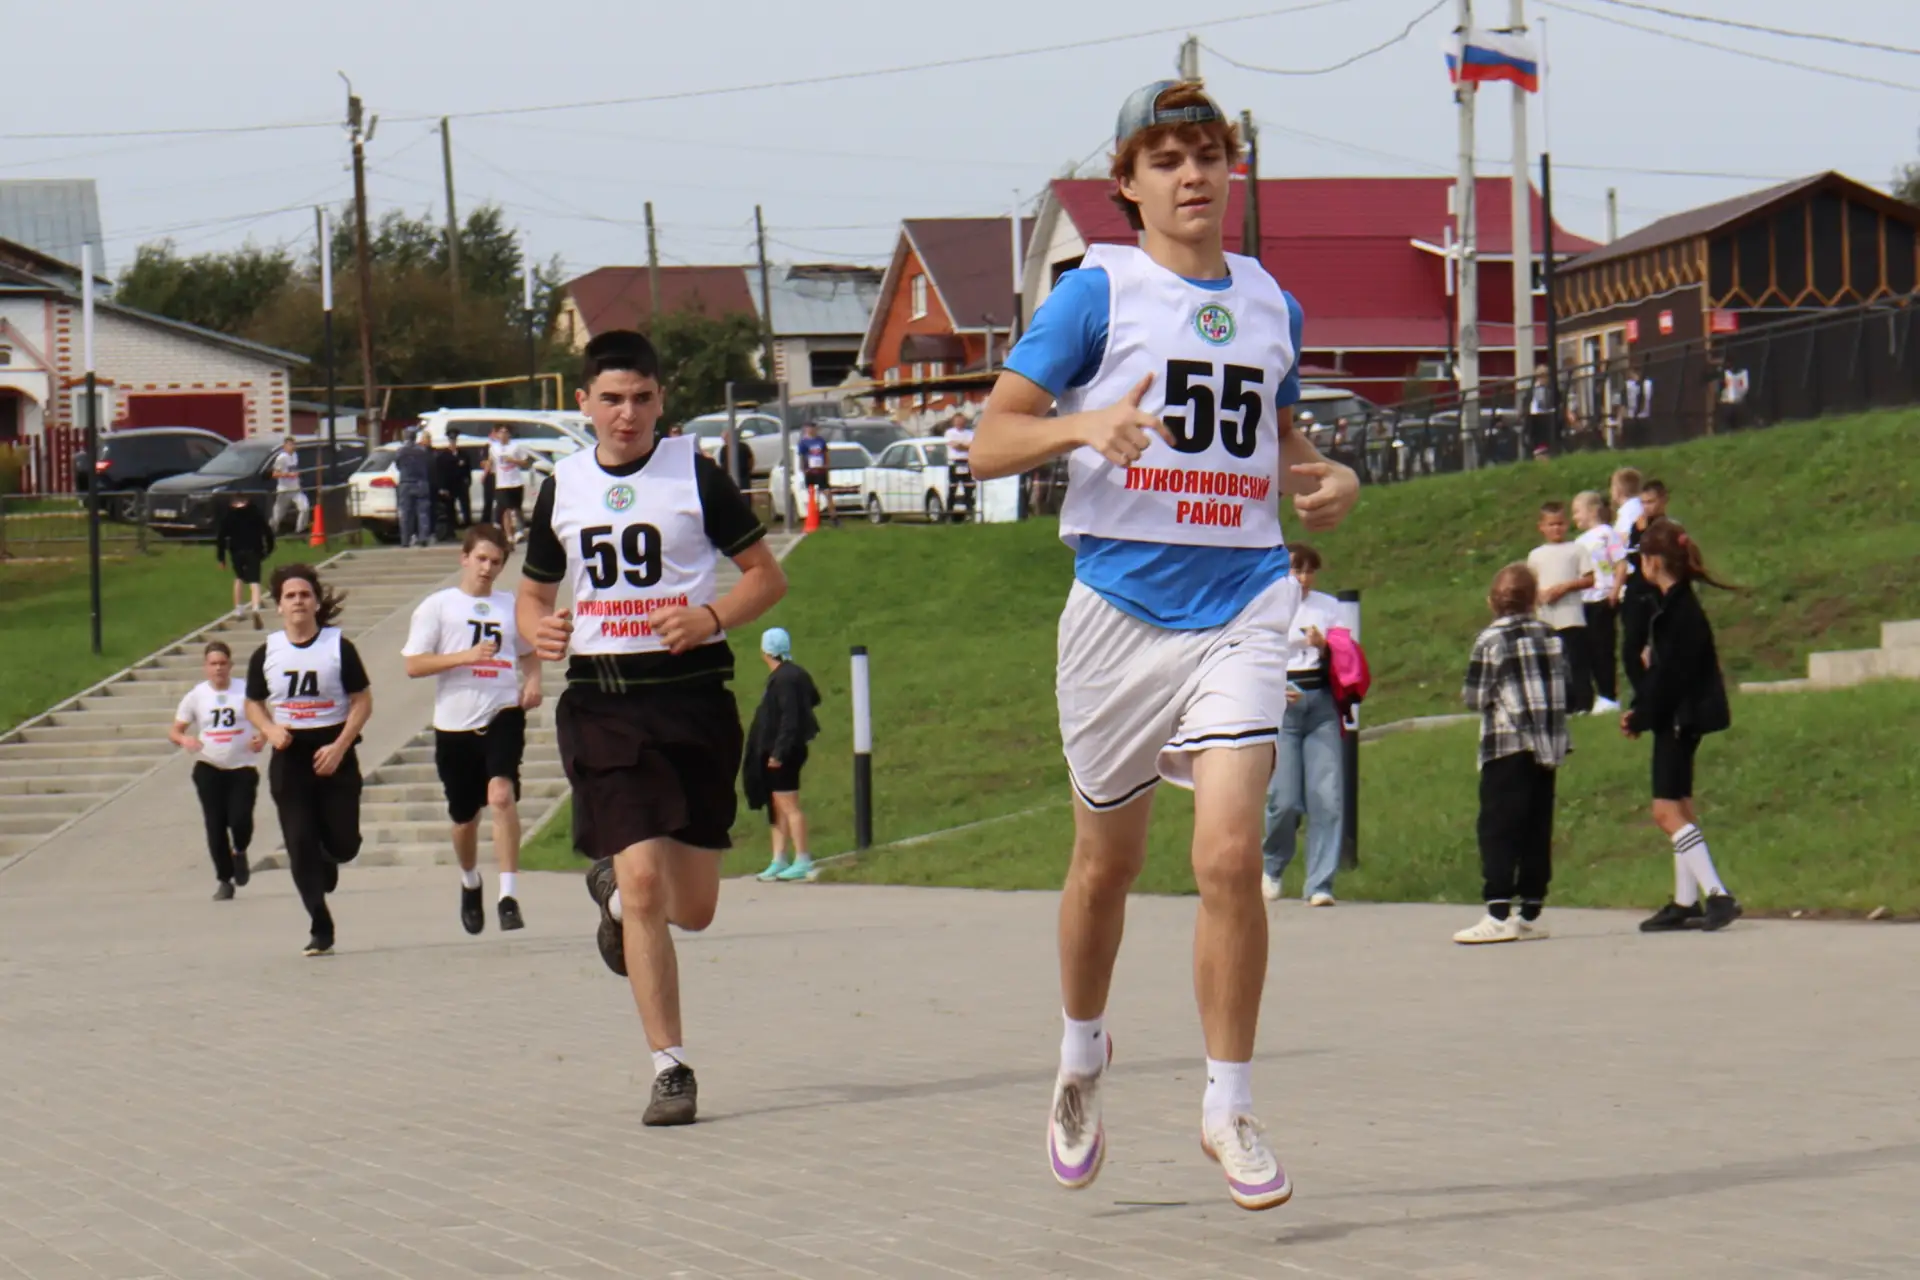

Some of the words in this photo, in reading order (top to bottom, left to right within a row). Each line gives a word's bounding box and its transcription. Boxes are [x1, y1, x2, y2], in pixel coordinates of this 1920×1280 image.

[1163, 359, 1264, 458] 55
[1125, 467, 1271, 501] ЛУКОЯНОВСКИЙ
[1176, 498, 1243, 528] РАЙОН
[580, 523, 662, 589] 59
[467, 620, 502, 656] 75
[601, 618, 652, 637] РАЙОН
[283, 670, 320, 698] 74
[211, 708, 236, 728] 73
